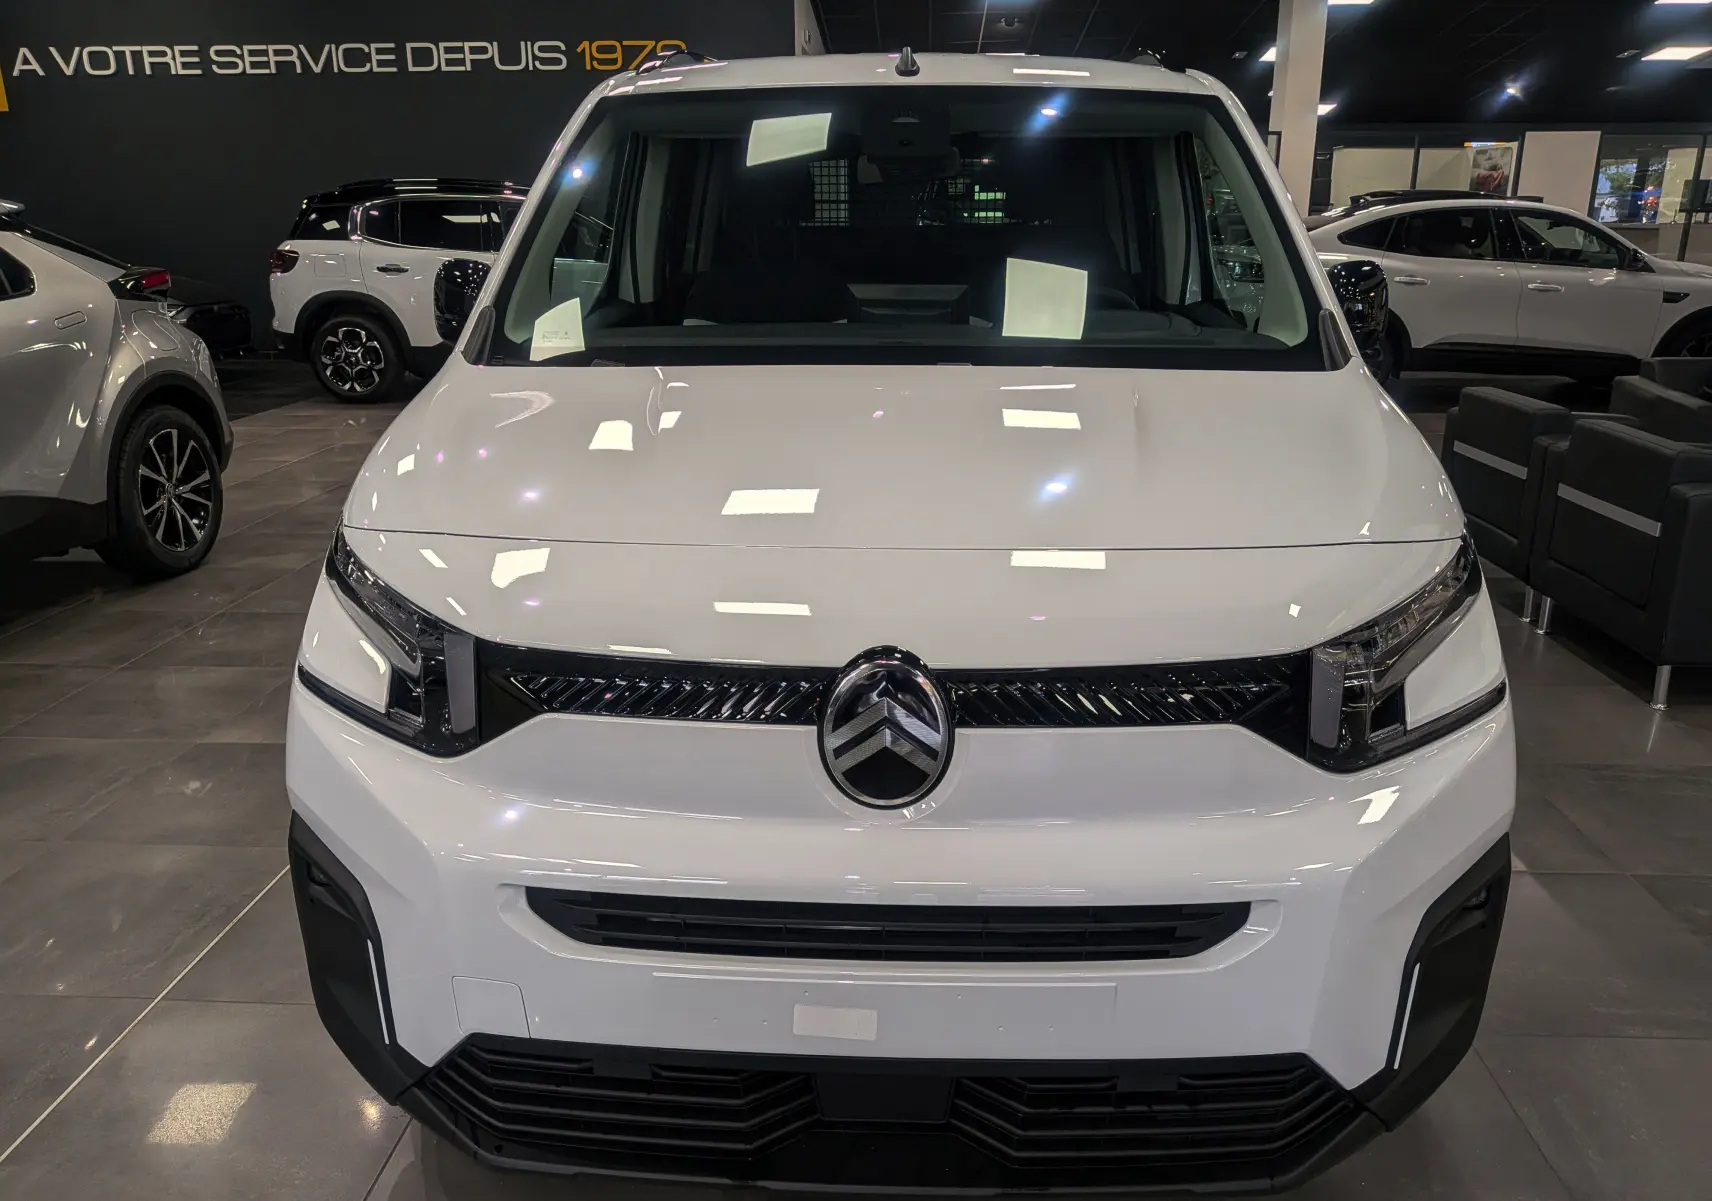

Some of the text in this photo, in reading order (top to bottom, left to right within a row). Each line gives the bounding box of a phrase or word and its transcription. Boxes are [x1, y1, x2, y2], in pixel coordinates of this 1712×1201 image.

[12, 47, 46, 77] A
[49, 45, 203, 76] VOTRE
[209, 43, 398, 75] SERVICE
[405, 40, 567, 72] DEPUIS
